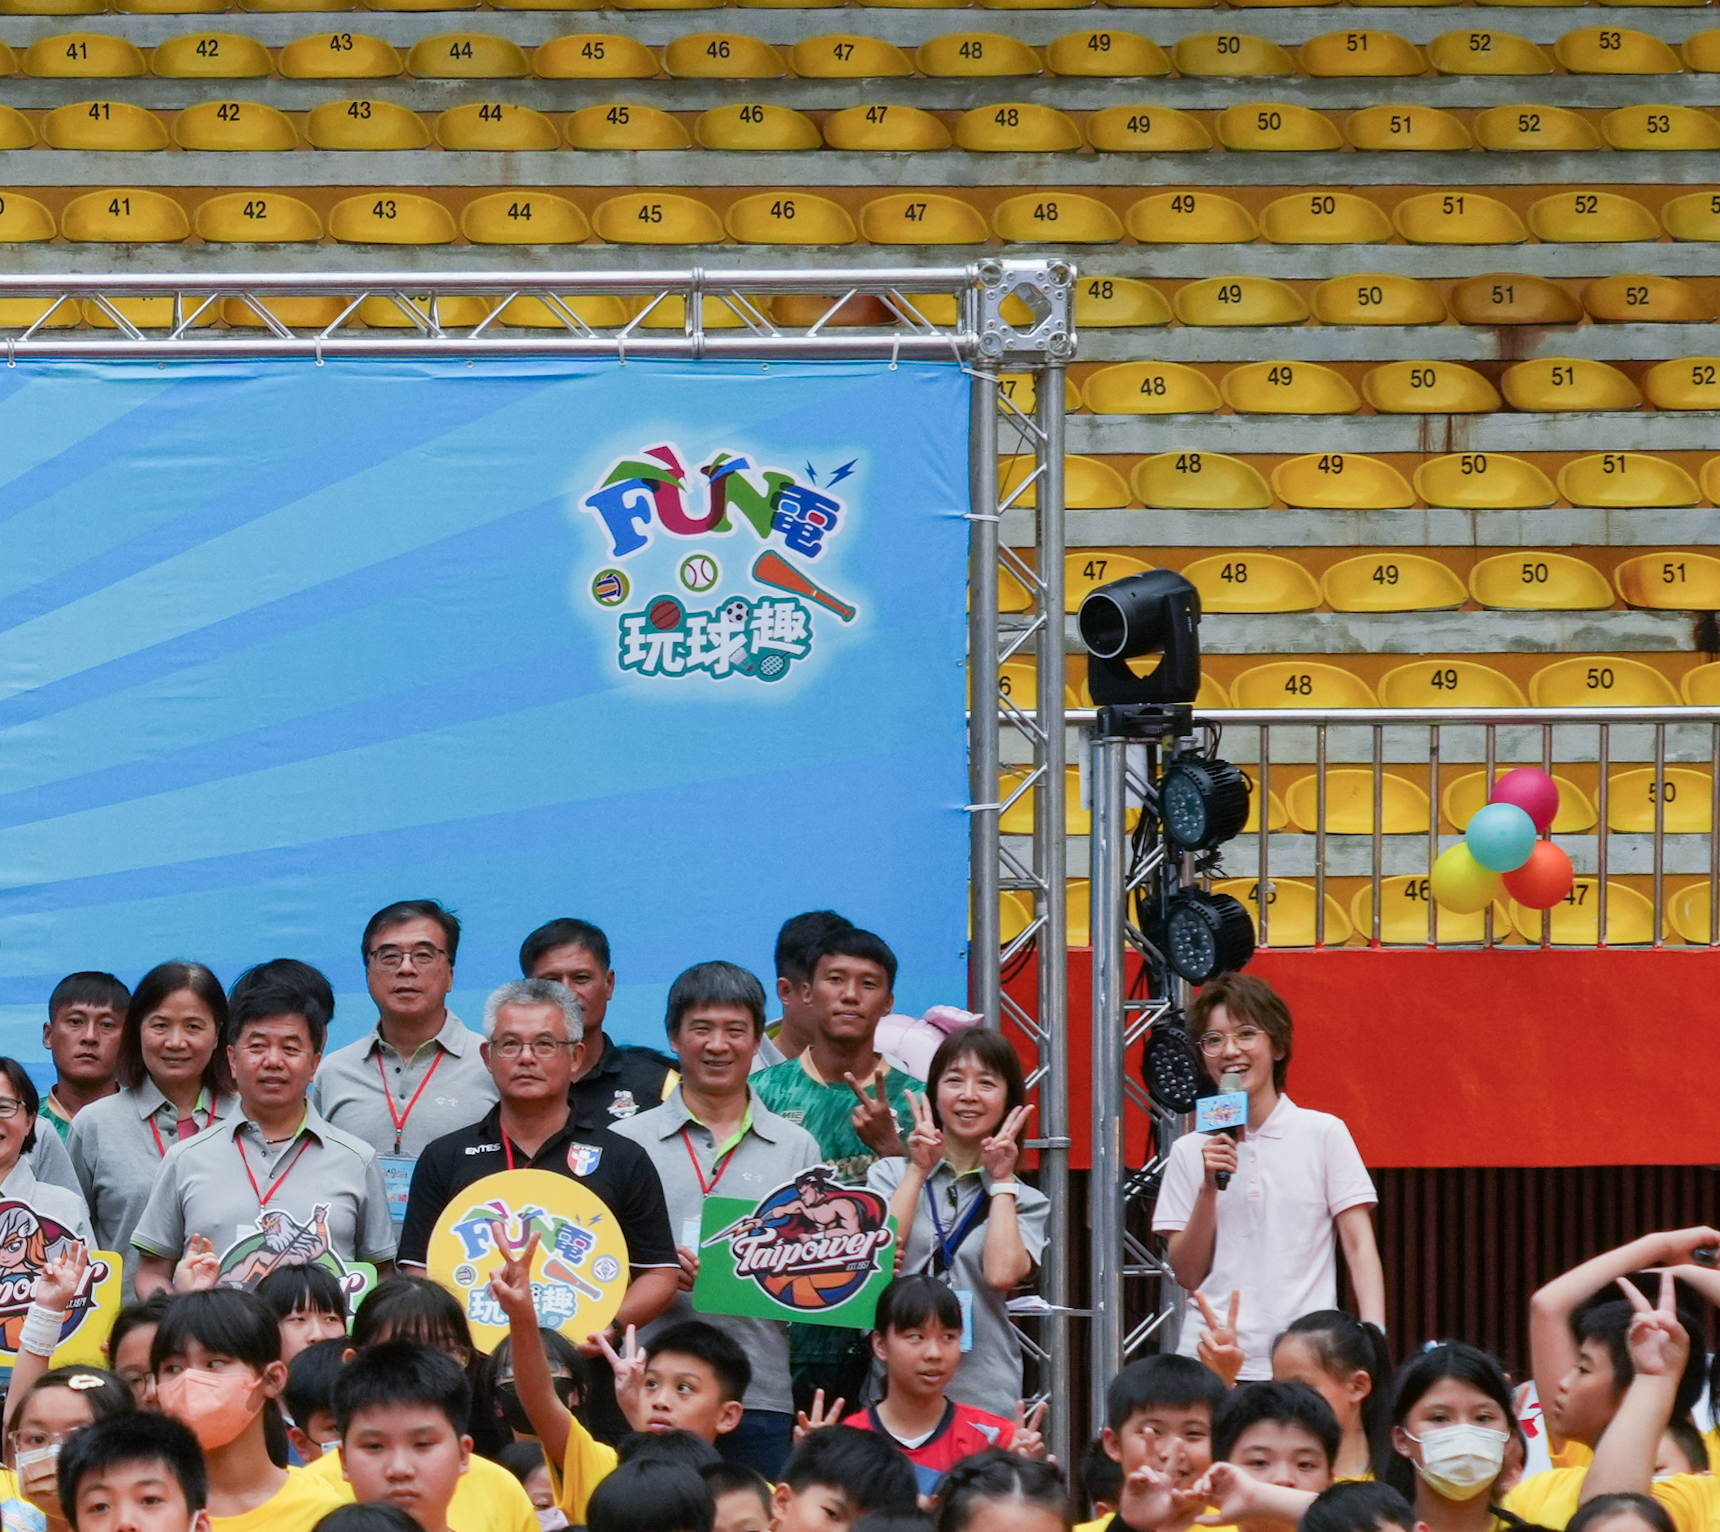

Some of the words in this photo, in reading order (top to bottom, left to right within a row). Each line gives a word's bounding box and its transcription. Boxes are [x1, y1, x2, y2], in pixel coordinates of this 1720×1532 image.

[65, 41, 87, 61] 41
[580, 41, 605, 61] 45
[1086, 32, 1111, 53] 49
[1346, 32, 1367, 53] 51
[1598, 30, 1621, 52] 53
[832, 42, 855, 62] 47
[87, 101, 110, 122] 41
[605, 105, 629, 126] 45
[864, 104, 888, 125] 47
[1125, 114, 1151, 135] 49
[1389, 114, 1411, 135] 51
[1646, 114, 1670, 135] 53
[242, 199, 267, 220] 42
[506, 201, 532, 222] 44
[769, 199, 795, 221] 46
[1310, 195, 1335, 216] 50
[1574, 194, 1598, 215] 52
[1087, 279, 1114, 301] 48
[1625, 285, 1650, 307] 52
[1139, 375, 1166, 397] 48
[1691, 364, 1716, 387] 52
[1174, 452, 1202, 475] 48
[1082, 559, 1108, 581] 47
[1662, 562, 1685, 585] 51
[621, 599, 810, 676] 玩球趣
[1284, 674, 1312, 697] 48
[1586, 667, 1614, 690] 50
[732, 1224, 893, 1278] Taipower
[469, 1283, 578, 1327] 玩趣
